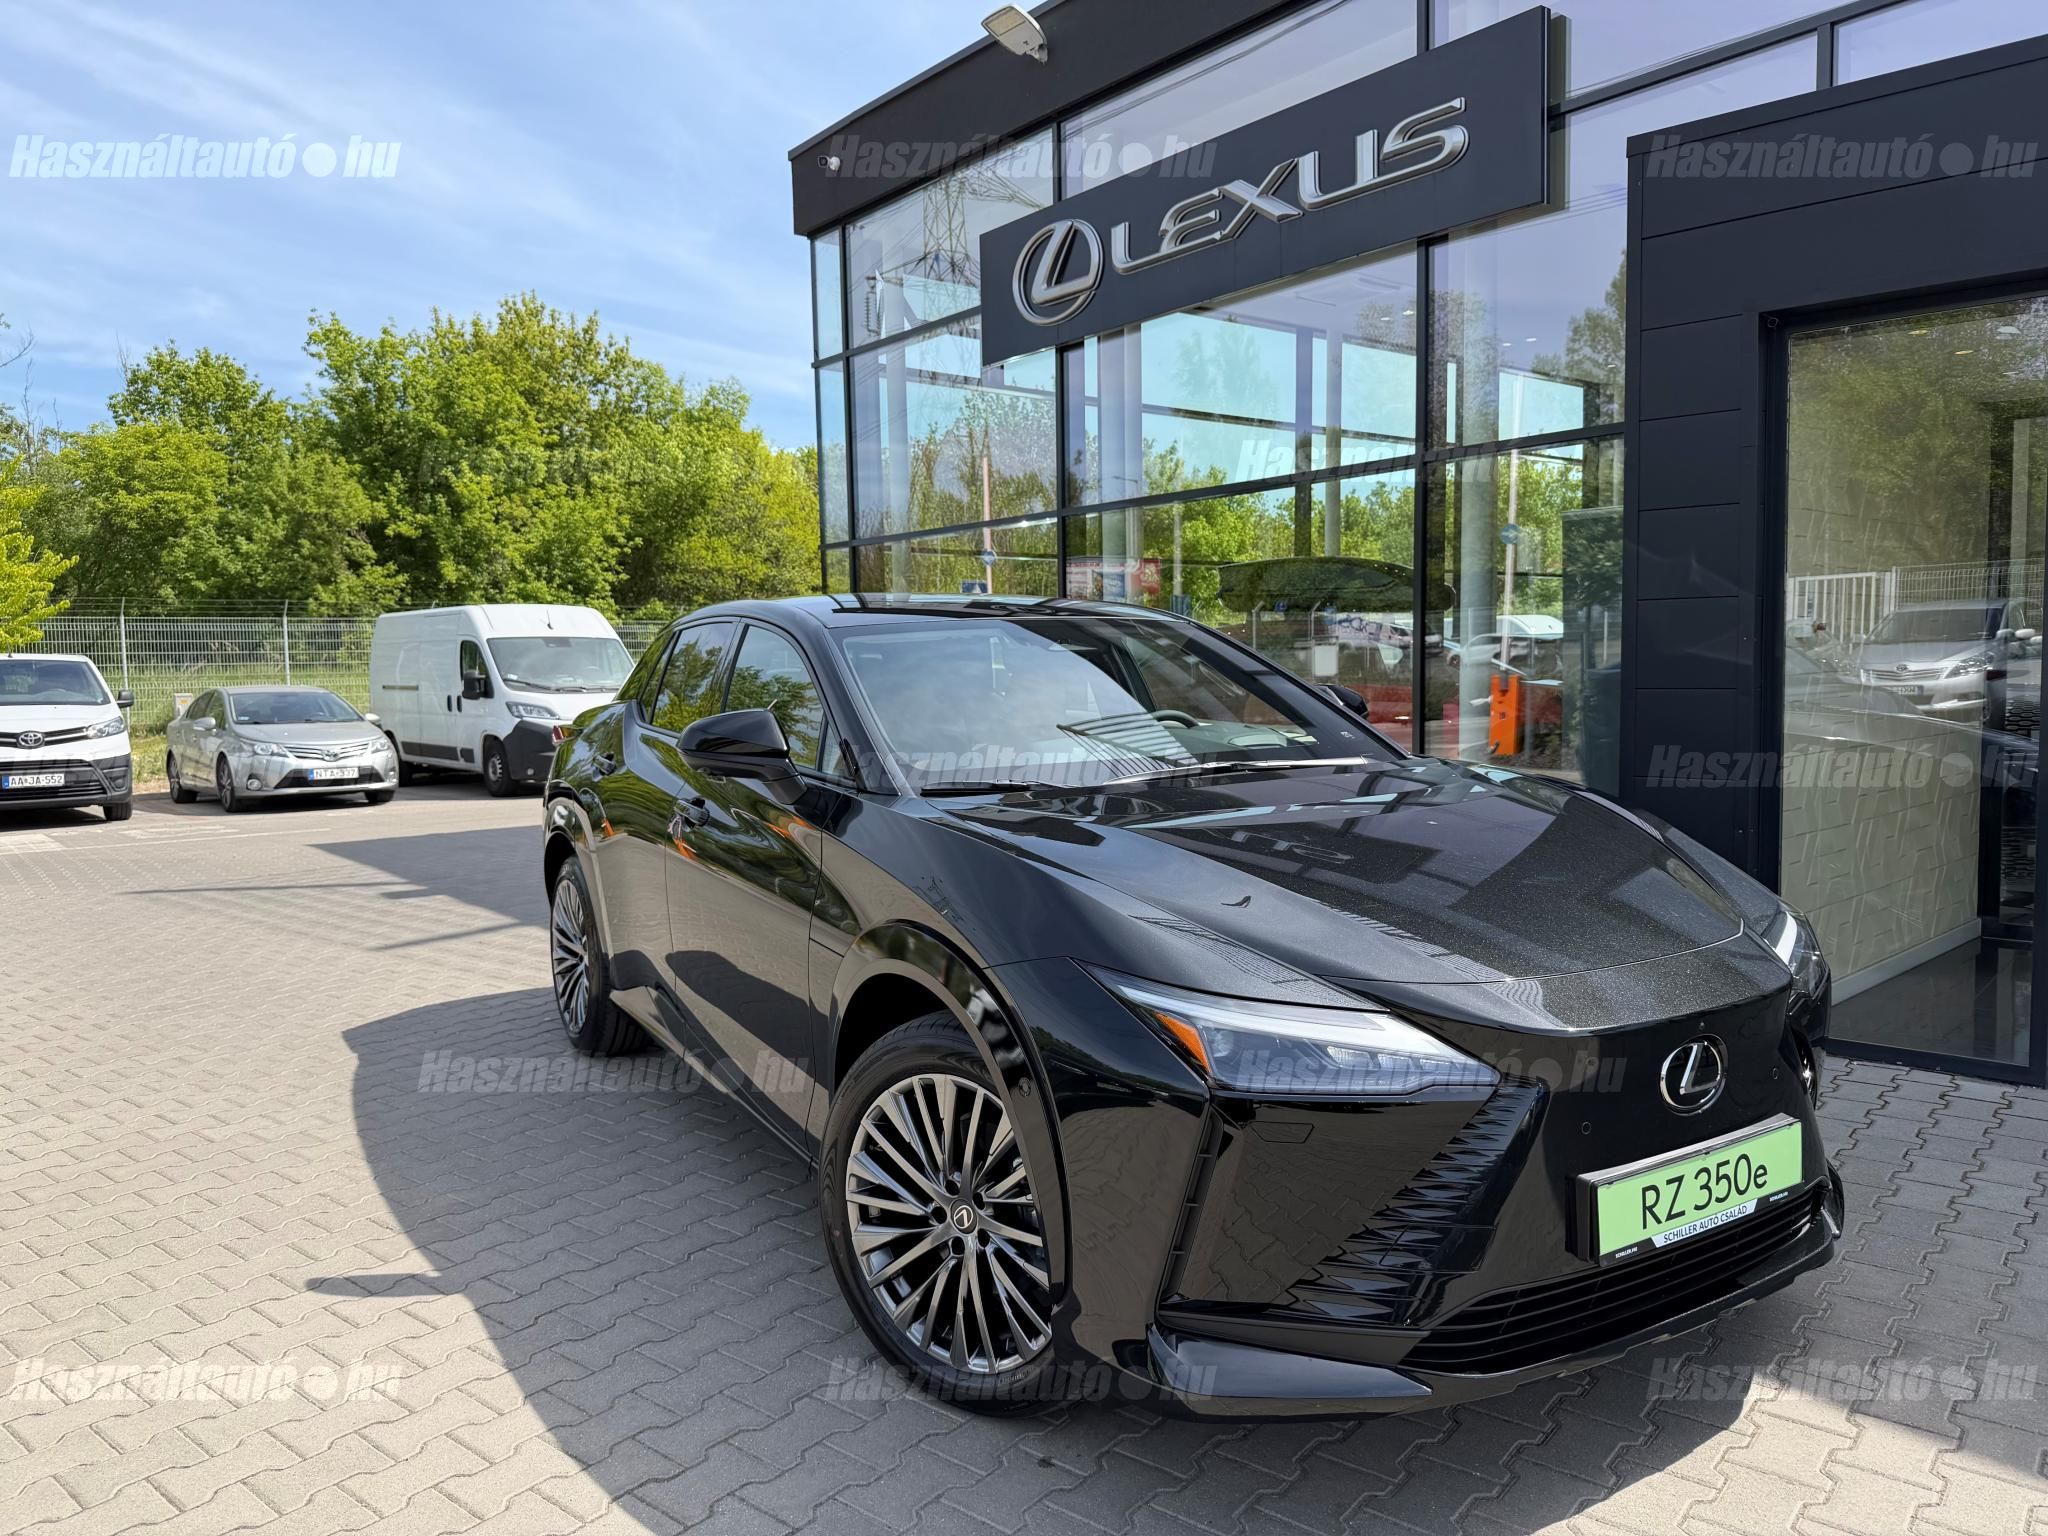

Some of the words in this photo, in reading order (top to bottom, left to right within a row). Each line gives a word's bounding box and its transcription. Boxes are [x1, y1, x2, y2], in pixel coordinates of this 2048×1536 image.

[1111, 96, 1470, 275] LEXUS
[1641, 1174, 1686, 1230] RZ
[1693, 1153, 1768, 1211] 350e
[1663, 1223, 1698, 1243] SCHILLER
[1720, 1204, 1748, 1223] CSALÁD
